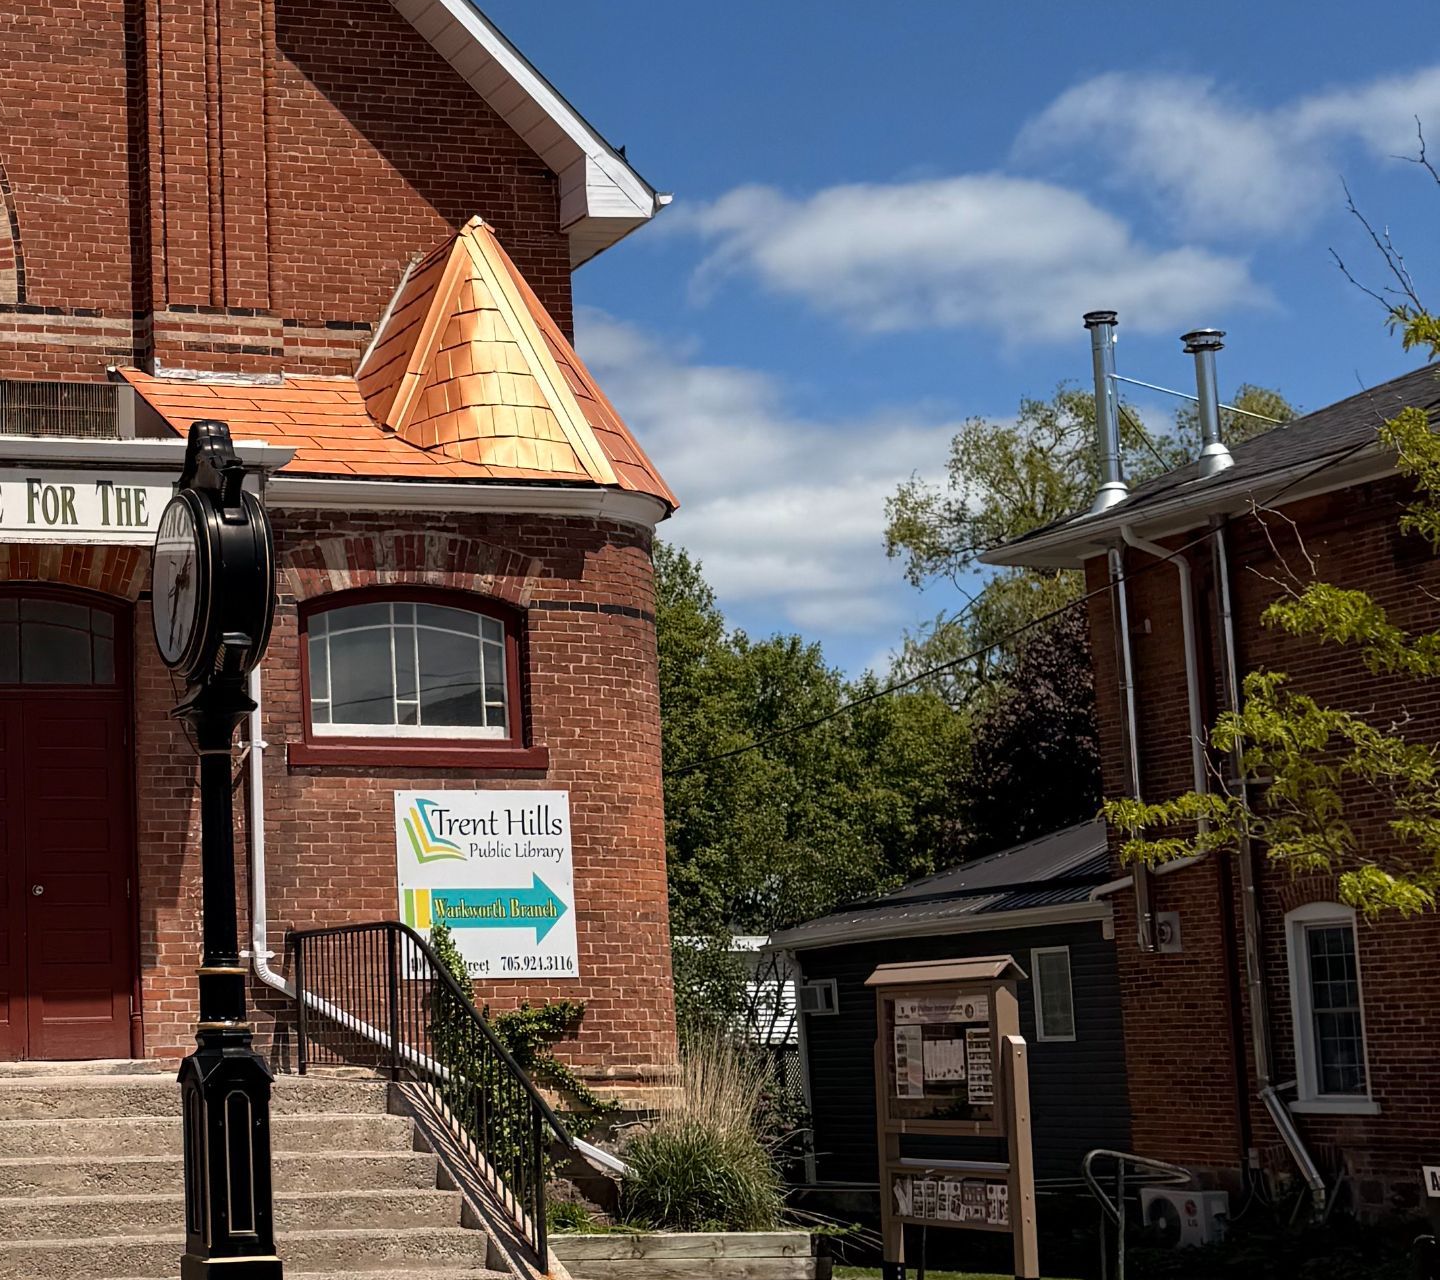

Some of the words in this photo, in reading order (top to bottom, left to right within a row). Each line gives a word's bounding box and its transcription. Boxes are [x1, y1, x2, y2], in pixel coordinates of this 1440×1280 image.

[26, 478, 78, 525] FOR
[96, 480, 149, 527] THE
[431, 808, 500, 836] Trent
[504, 804, 563, 836] Hills
[469, 840, 512, 858] Public
[515, 840, 564, 863] Library
[433, 897, 506, 919] Warkworth
[509, 898, 558, 919] Branch
[500, 955, 573, 971] 705.924.3116
